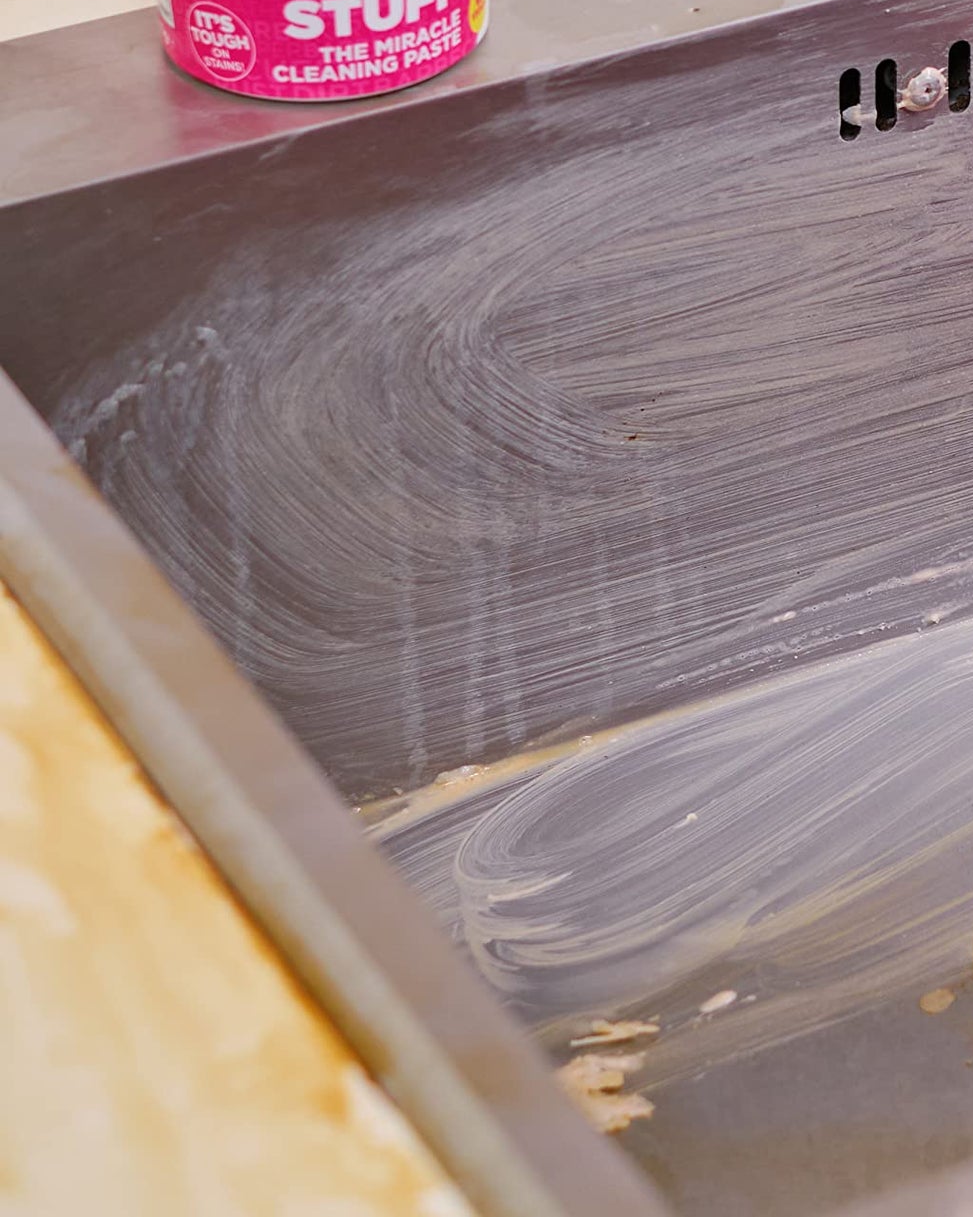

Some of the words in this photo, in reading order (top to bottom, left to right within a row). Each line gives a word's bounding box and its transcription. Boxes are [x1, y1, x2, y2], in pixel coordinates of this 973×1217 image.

[194, 9, 235, 34] IT'S
[190, 25, 251, 51] TOUGH
[318, 43, 369, 64] THE
[374, 7, 462, 57] MIRACLE
[211, 47, 231, 60] ON
[272, 54, 399, 84] CLEANING
[404, 26, 462, 68] PASTE
